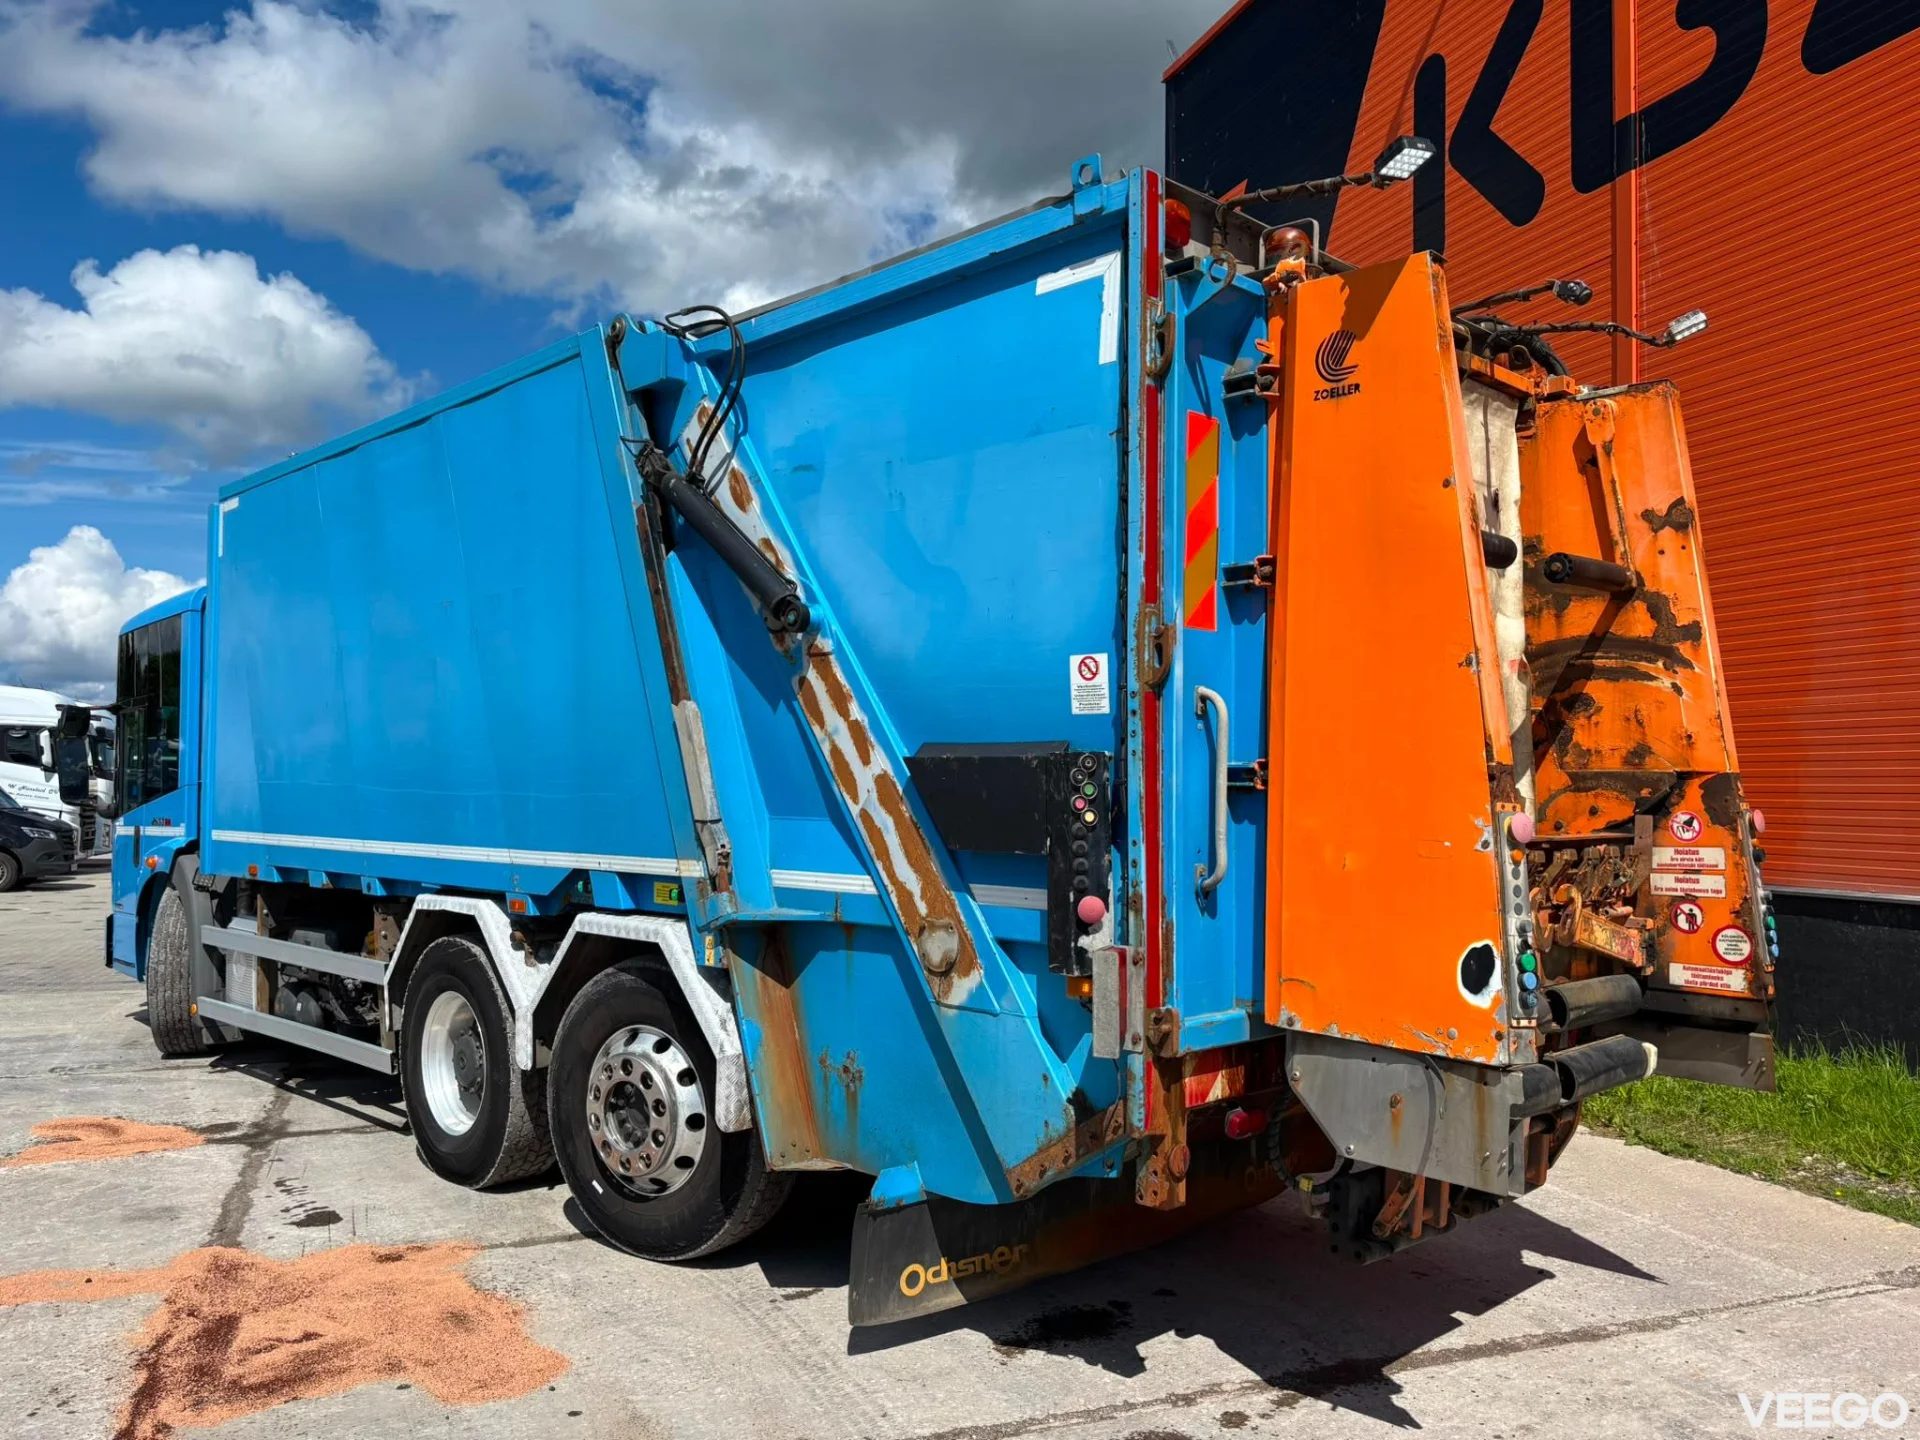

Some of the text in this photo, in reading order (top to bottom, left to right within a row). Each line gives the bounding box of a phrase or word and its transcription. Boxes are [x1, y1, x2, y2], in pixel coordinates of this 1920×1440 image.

[1313, 383, 1361, 402] ZOELLER
[1674, 848, 1700, 856] Hoiatus
[1674, 876, 1700, 884] Hoiatus
[899, 1243, 1029, 1298] Ochsner
